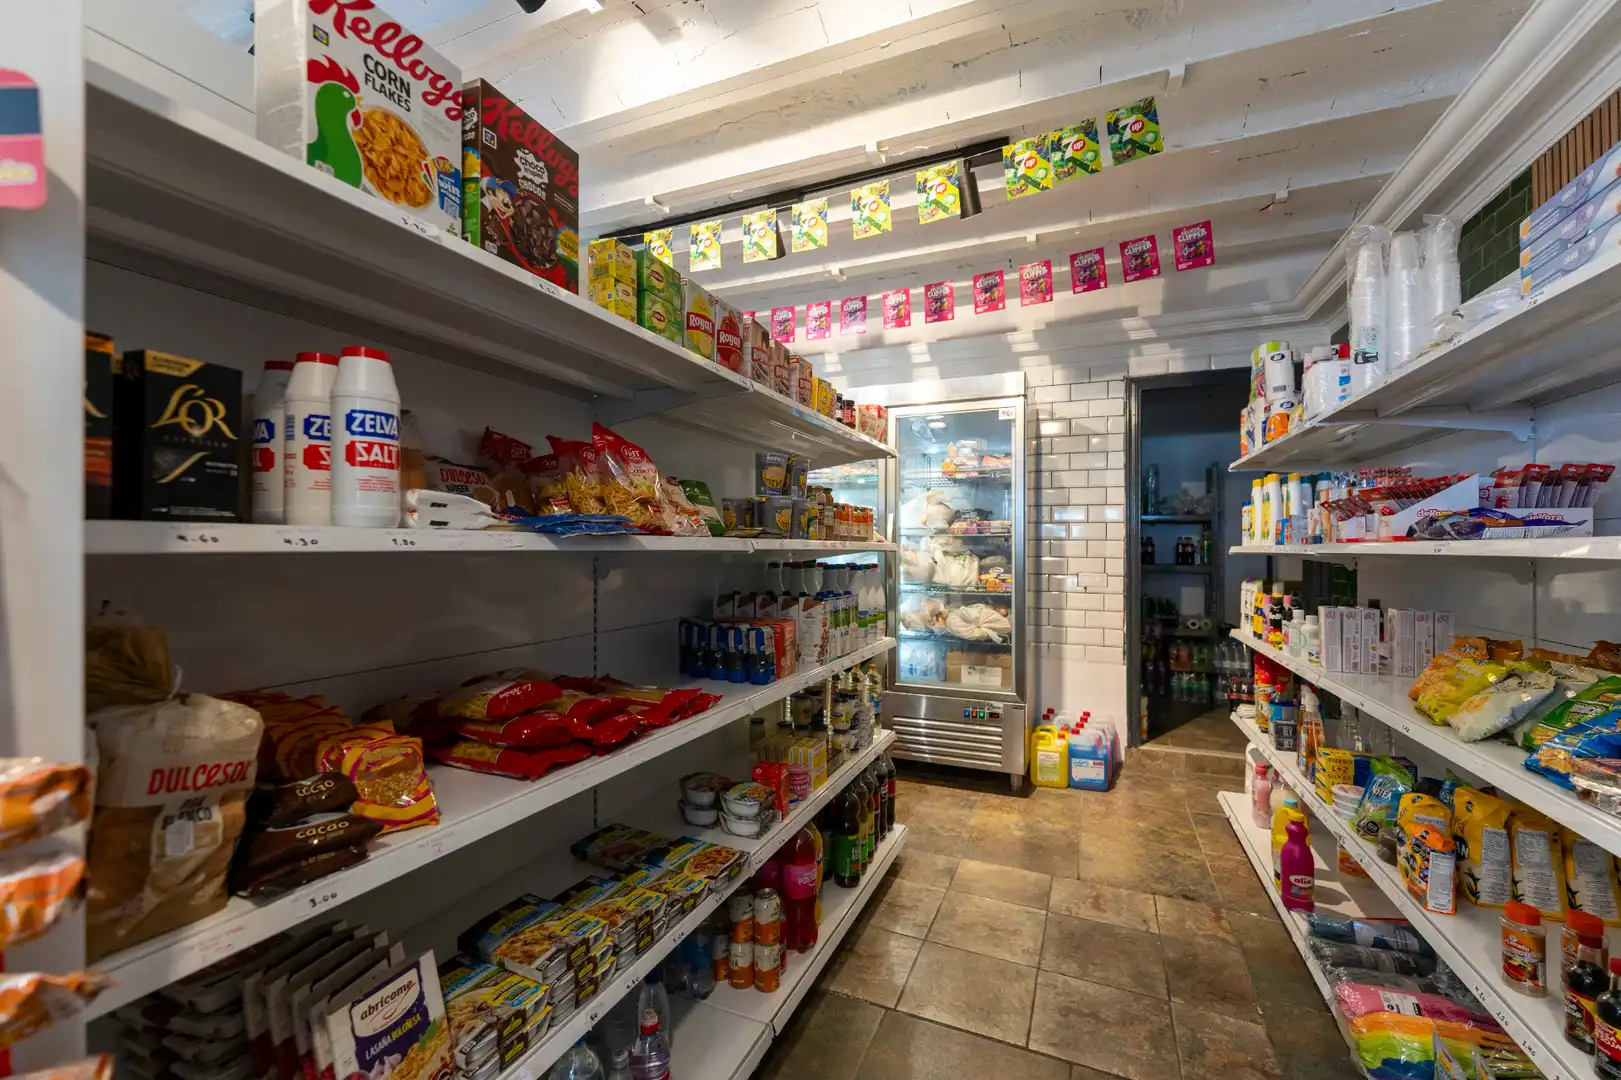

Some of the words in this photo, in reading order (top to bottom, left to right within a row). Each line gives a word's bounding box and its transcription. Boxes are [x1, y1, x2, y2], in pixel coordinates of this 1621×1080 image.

[363, 53, 411, 98] CORN
[364, 73, 411, 113] FLAKES
[689, 314, 713, 334] Royal
[719, 330, 741, 348] Royal
[351, 412, 399, 437] ZELVA
[355, 442, 399, 465] SALT
[295, 820, 350, 839] cacao
